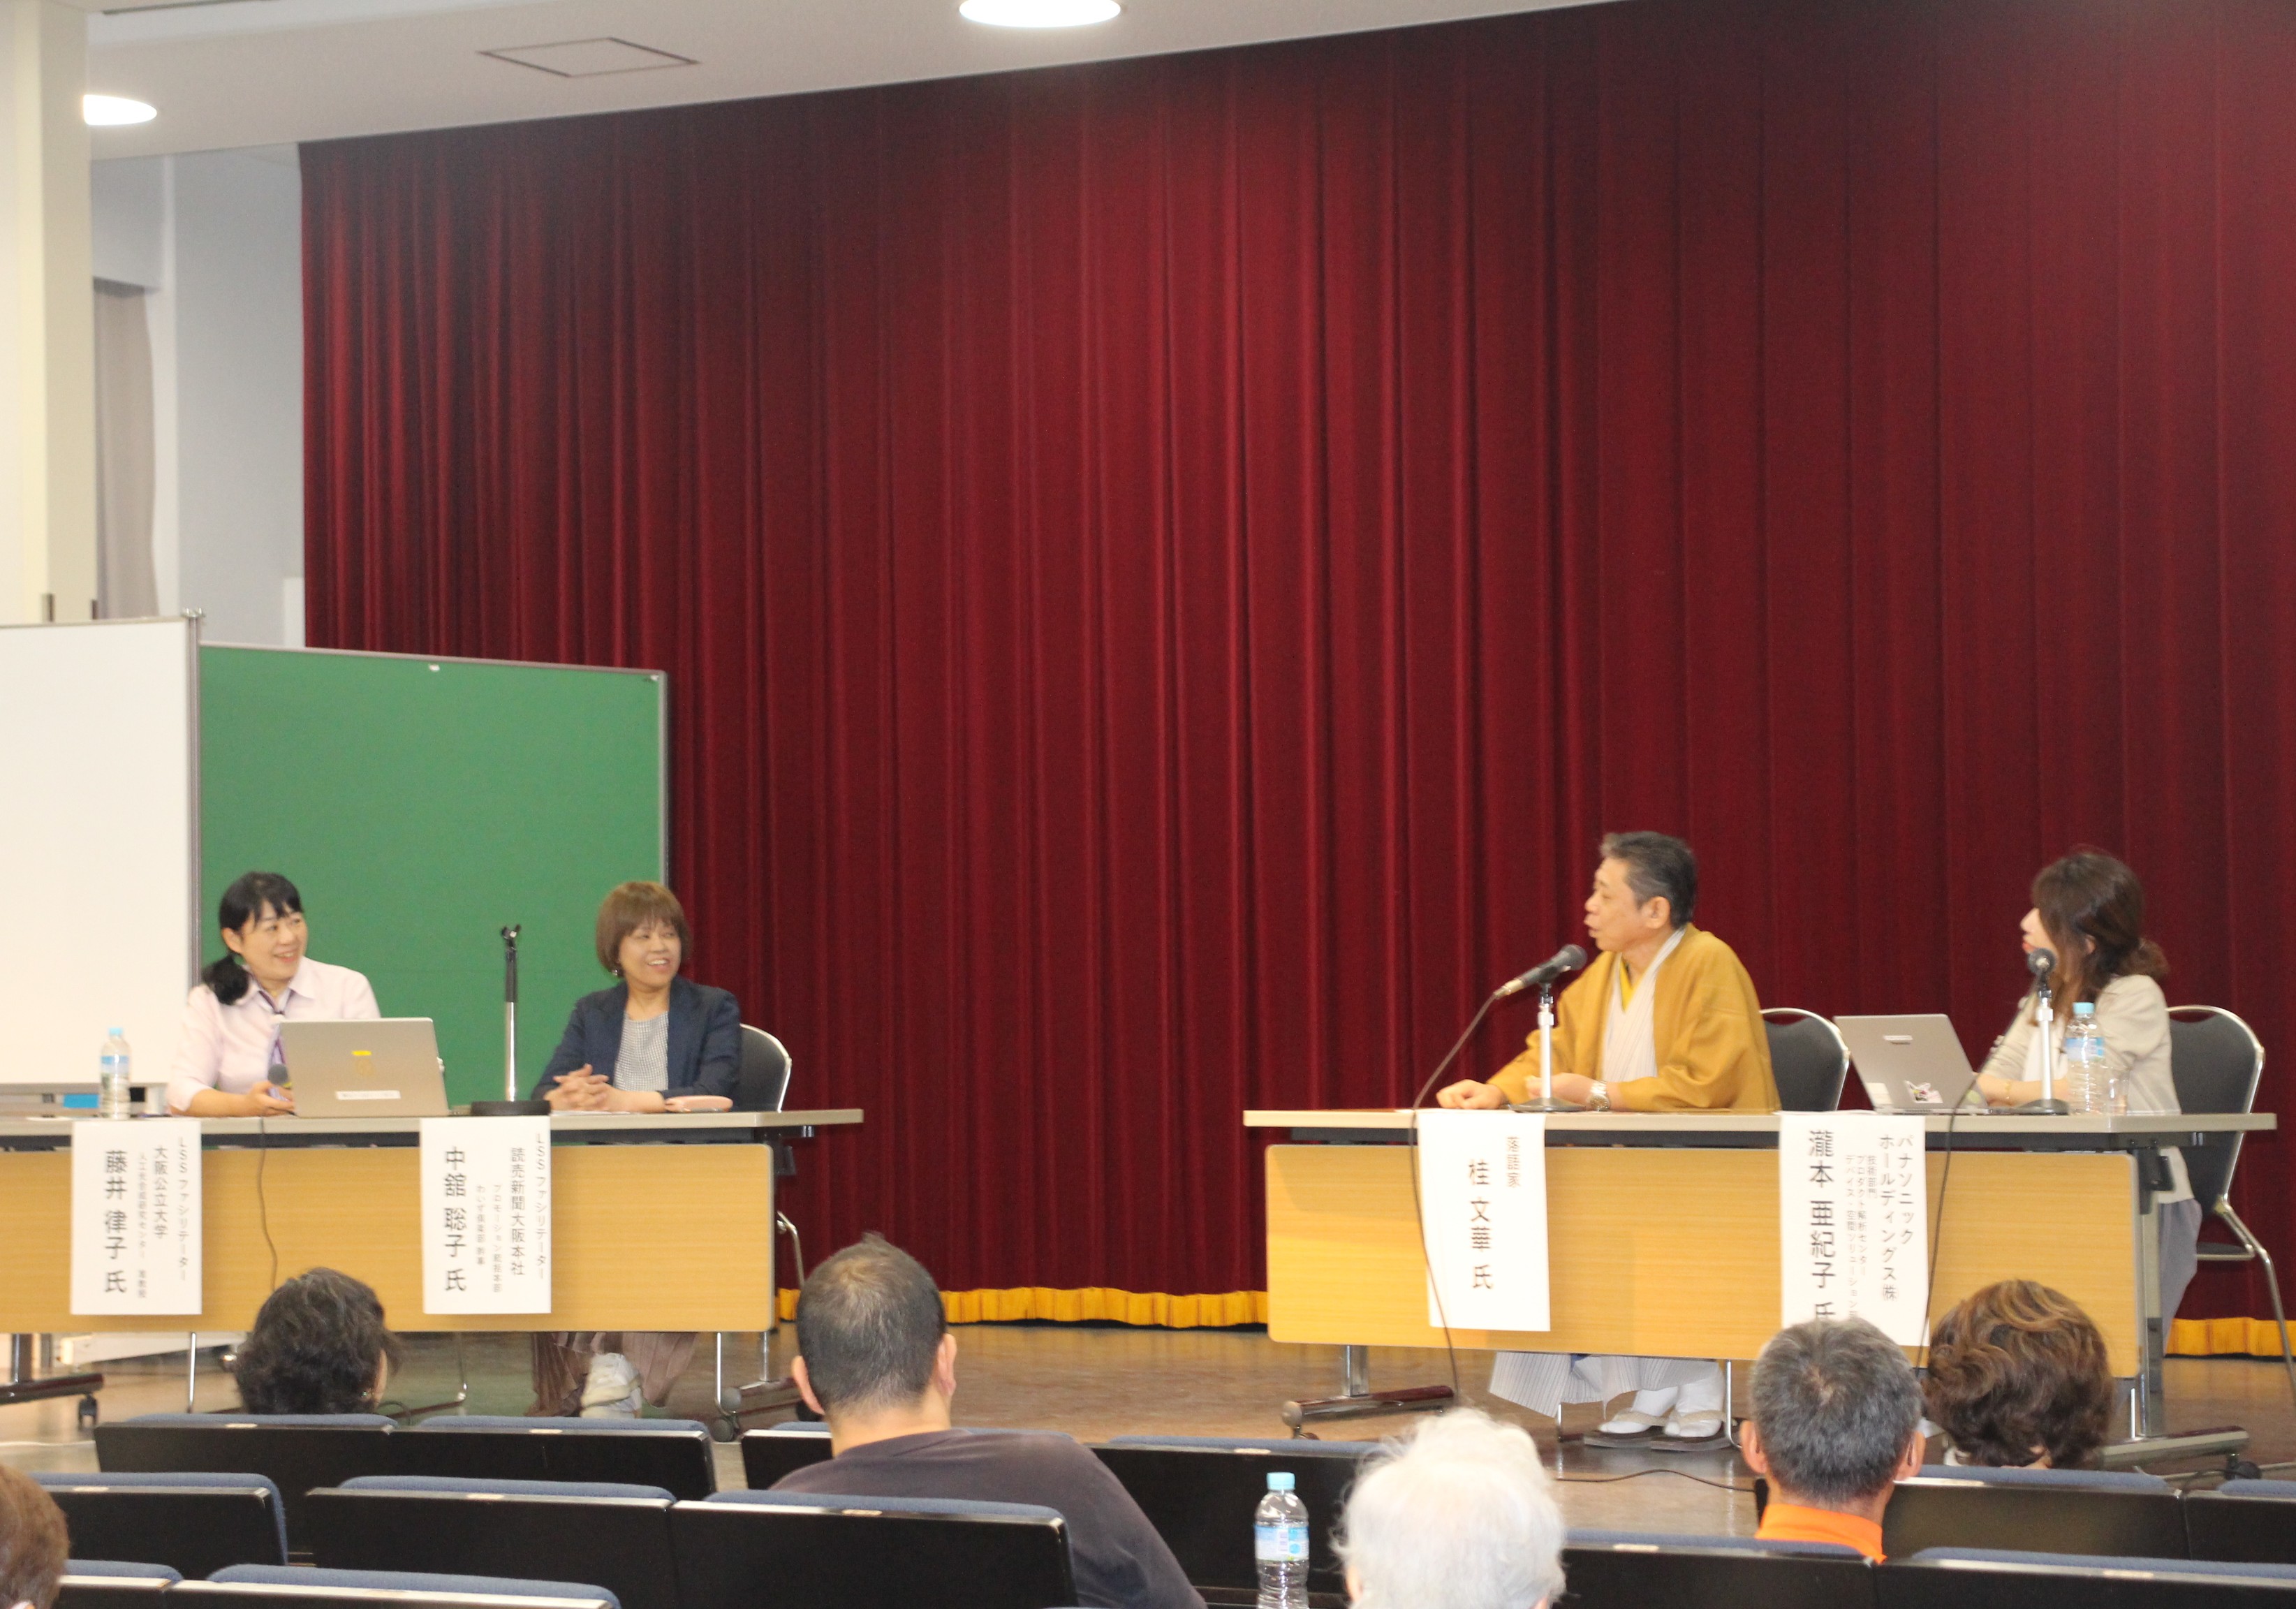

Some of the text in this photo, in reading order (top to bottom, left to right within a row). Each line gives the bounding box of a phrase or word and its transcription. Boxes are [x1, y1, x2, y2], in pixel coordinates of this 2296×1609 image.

[1469, 1159, 1491, 1186] 桂
[1507, 1136, 1521, 1188] 落語家
[154, 1146, 168, 1239] 大阪公立大学
[1898, 1134, 1914, 1244] パナソニック
[510, 1147, 525, 1276] 読売新聞大阪本社
[105, 1270, 127, 1293] 氏
[445, 1268, 466, 1292] 氏
[1472, 1264, 1494, 1290] 氏
